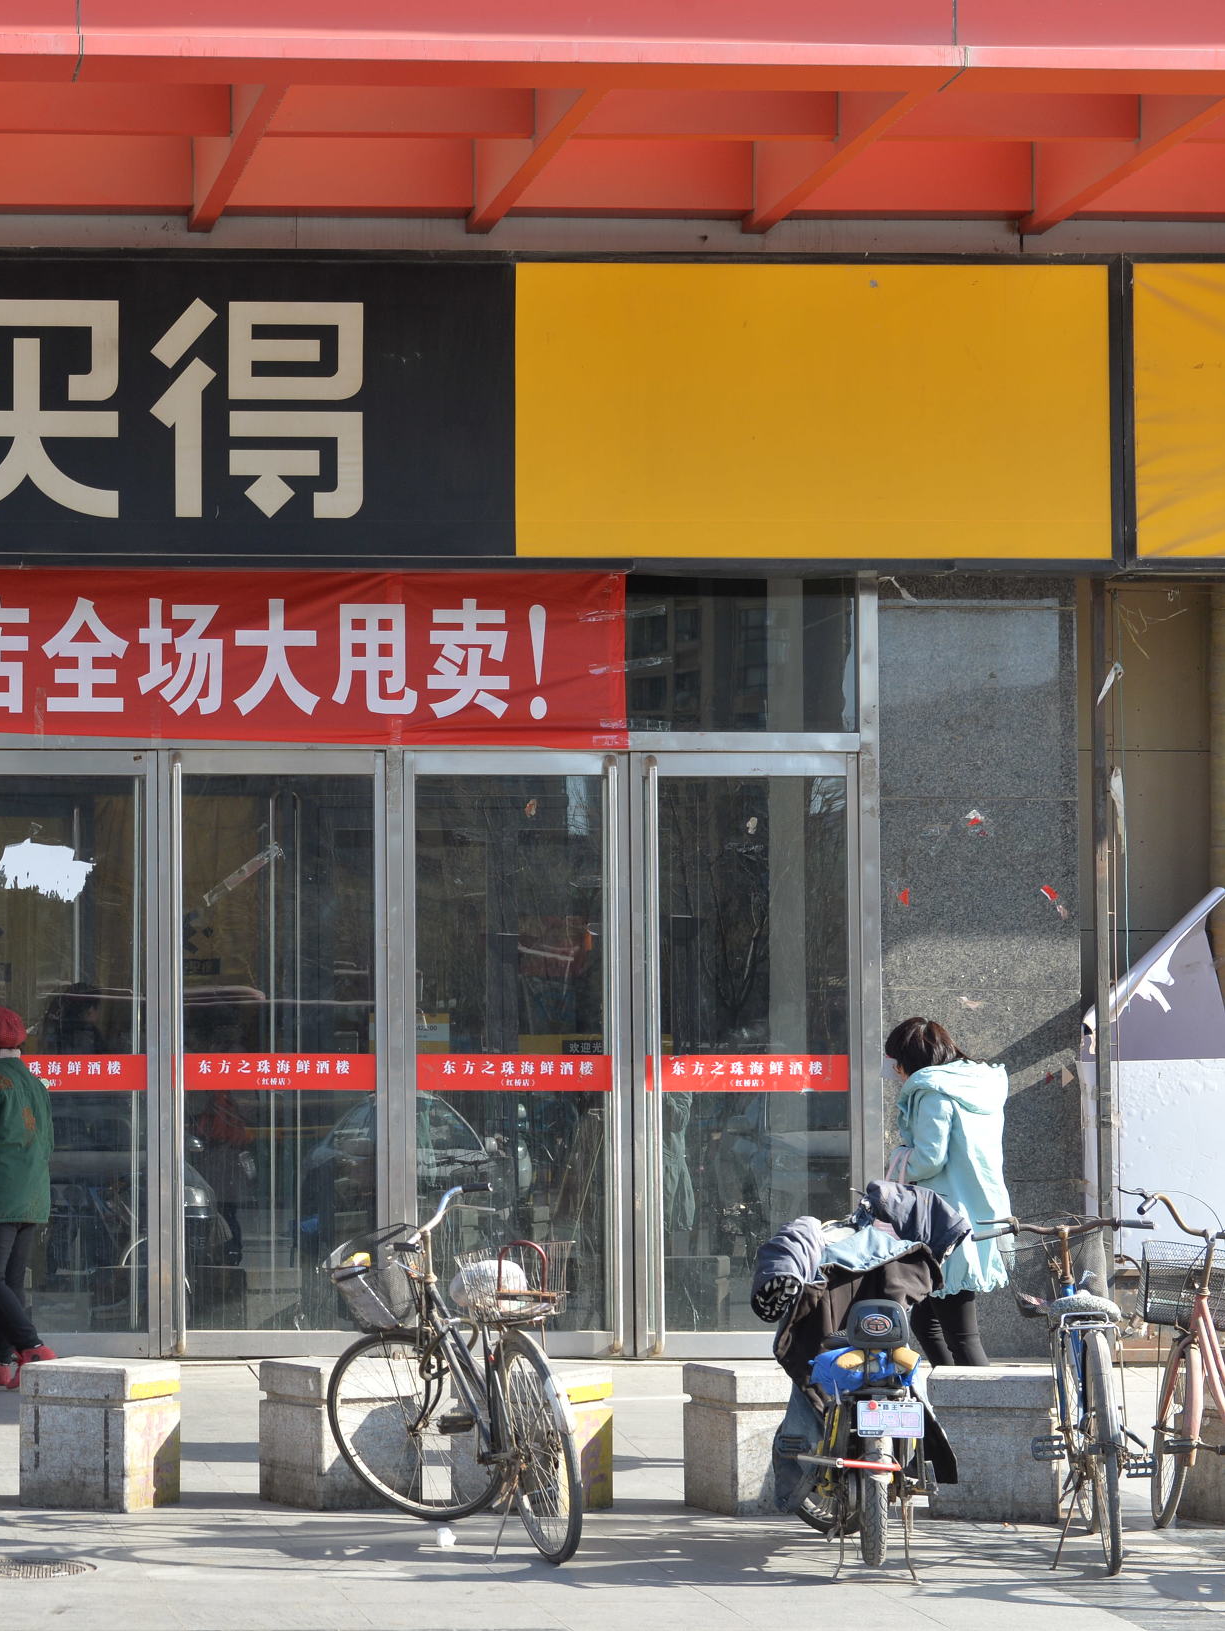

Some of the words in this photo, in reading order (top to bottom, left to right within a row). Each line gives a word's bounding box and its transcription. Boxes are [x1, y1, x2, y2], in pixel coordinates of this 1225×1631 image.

[198, 1059, 350, 1075] 东方之珠海鲜酒楼
[441, 1060, 595, 1076] 东方之珠海鲜酒楼
[671, 1061, 824, 1076] 东方之珠海鲜酒楼
